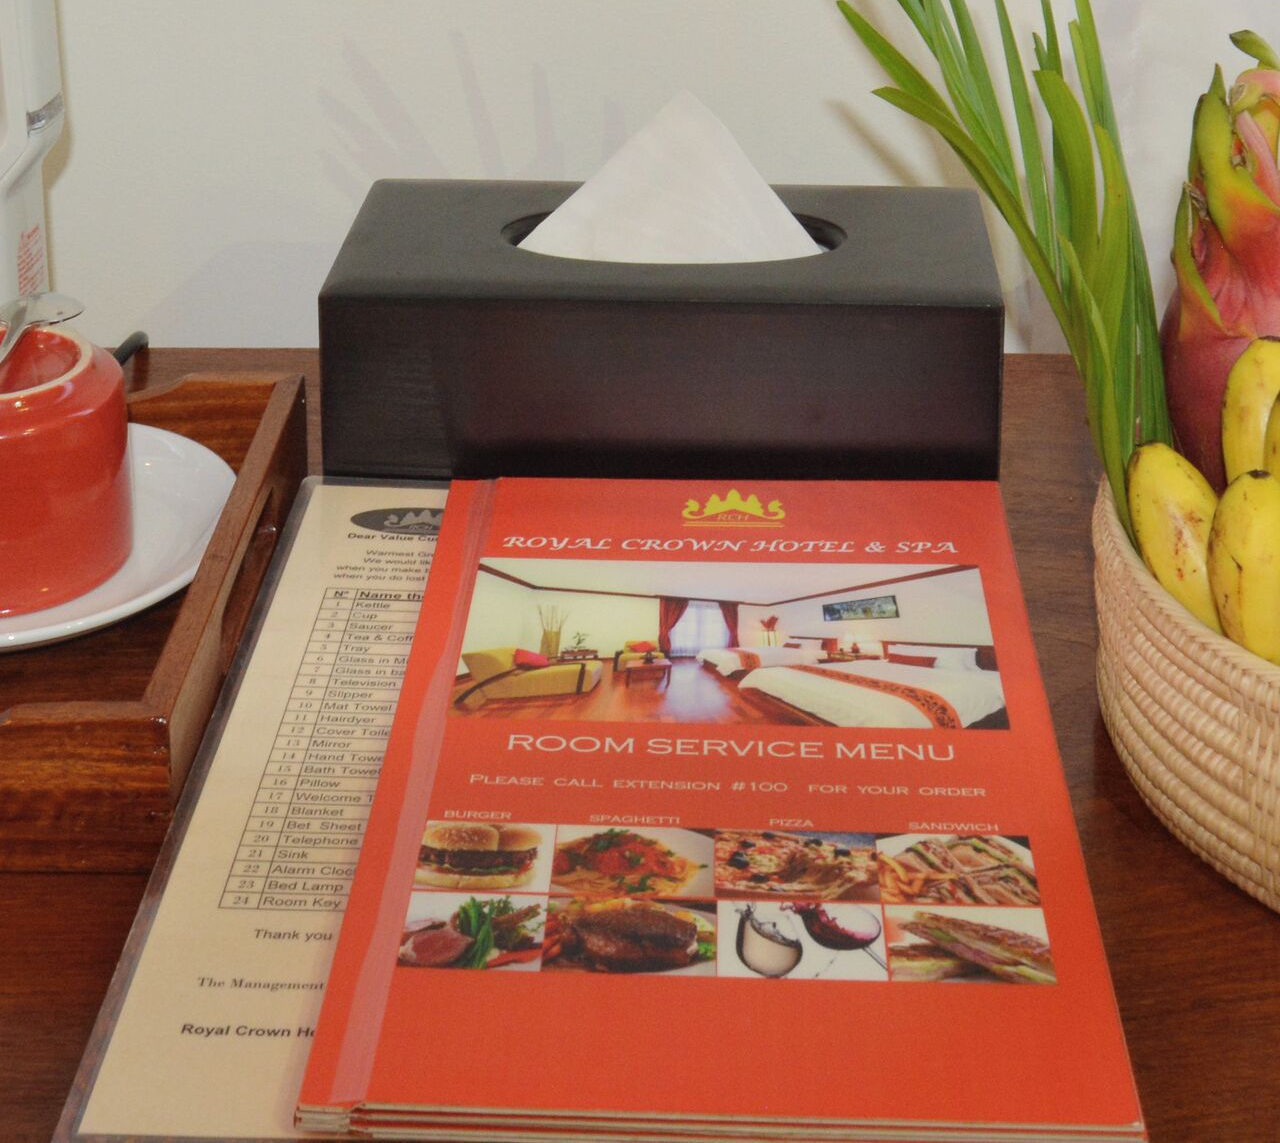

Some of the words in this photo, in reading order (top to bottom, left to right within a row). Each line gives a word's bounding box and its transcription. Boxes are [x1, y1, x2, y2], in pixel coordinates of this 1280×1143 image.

[347, 532, 376, 540] Dear
[502, 535, 613, 551] ROYAL
[620, 537, 748, 554] CROWN
[751, 539, 856, 555] HOTEL
[863, 541, 886, 554] &
[895, 541, 959, 555] SPA
[359, 591, 402, 600] Name
[352, 612, 378, 622] Cup
[349, 622, 394, 631] Saucer
[347, 633, 370, 641] Tea
[343, 644, 370, 654] Tray
[338, 656, 375, 664] Glass
[333, 678, 397, 687] Television
[327, 690, 373, 700] Slipper
[324, 702, 349, 710] Mat
[353, 703, 393, 712] Towel
[320, 714, 376, 724] Hairdyer
[316, 727, 355, 736] Cover
[311, 739, 353, 748] Mirror
[506, 734, 635, 755] ROOM
[646, 738, 824, 759] SERVICE
[835, 743, 956, 762] MENU
[307, 752, 345, 762] Hand
[304, 765, 336, 775] Bath
[299, 779, 341, 788] Pillow
[553, 776, 604, 789] CALL
[612, 778, 721, 791] EXTENSION
[731, 781, 789, 793] #100
[807, 783, 848, 796] FOR
[856, 785, 910, 797] YOUR
[918, 786, 987, 798] ORDER
[294, 793, 362, 803] Welcome
[290, 807, 344, 817] Blanket
[443, 808, 512, 821] BURGER
[588, 813, 681, 826] SPAGHETTI
[768, 817, 815, 828] PIZZA
[286, 821, 311, 831] Bet
[319, 821, 362, 832] Sheet
[908, 821, 1000, 834] SANDWICH
[283, 834, 359, 847] Telephone
[277, 849, 310, 860] Sink
[272, 865, 316, 876] Alarm
[267, 879, 298, 891] Bed
[302, 881, 344, 893] Lamp
[262, 896, 308, 907] Room
[312, 897, 342, 909] Key
[254, 928, 300, 941] Thank
[305, 931, 333, 943] you
[197, 976, 227, 988] The
[230, 978, 325, 992] Management
[180, 1023, 230, 1038] Royal
[235, 1025, 292, 1038] Crown
